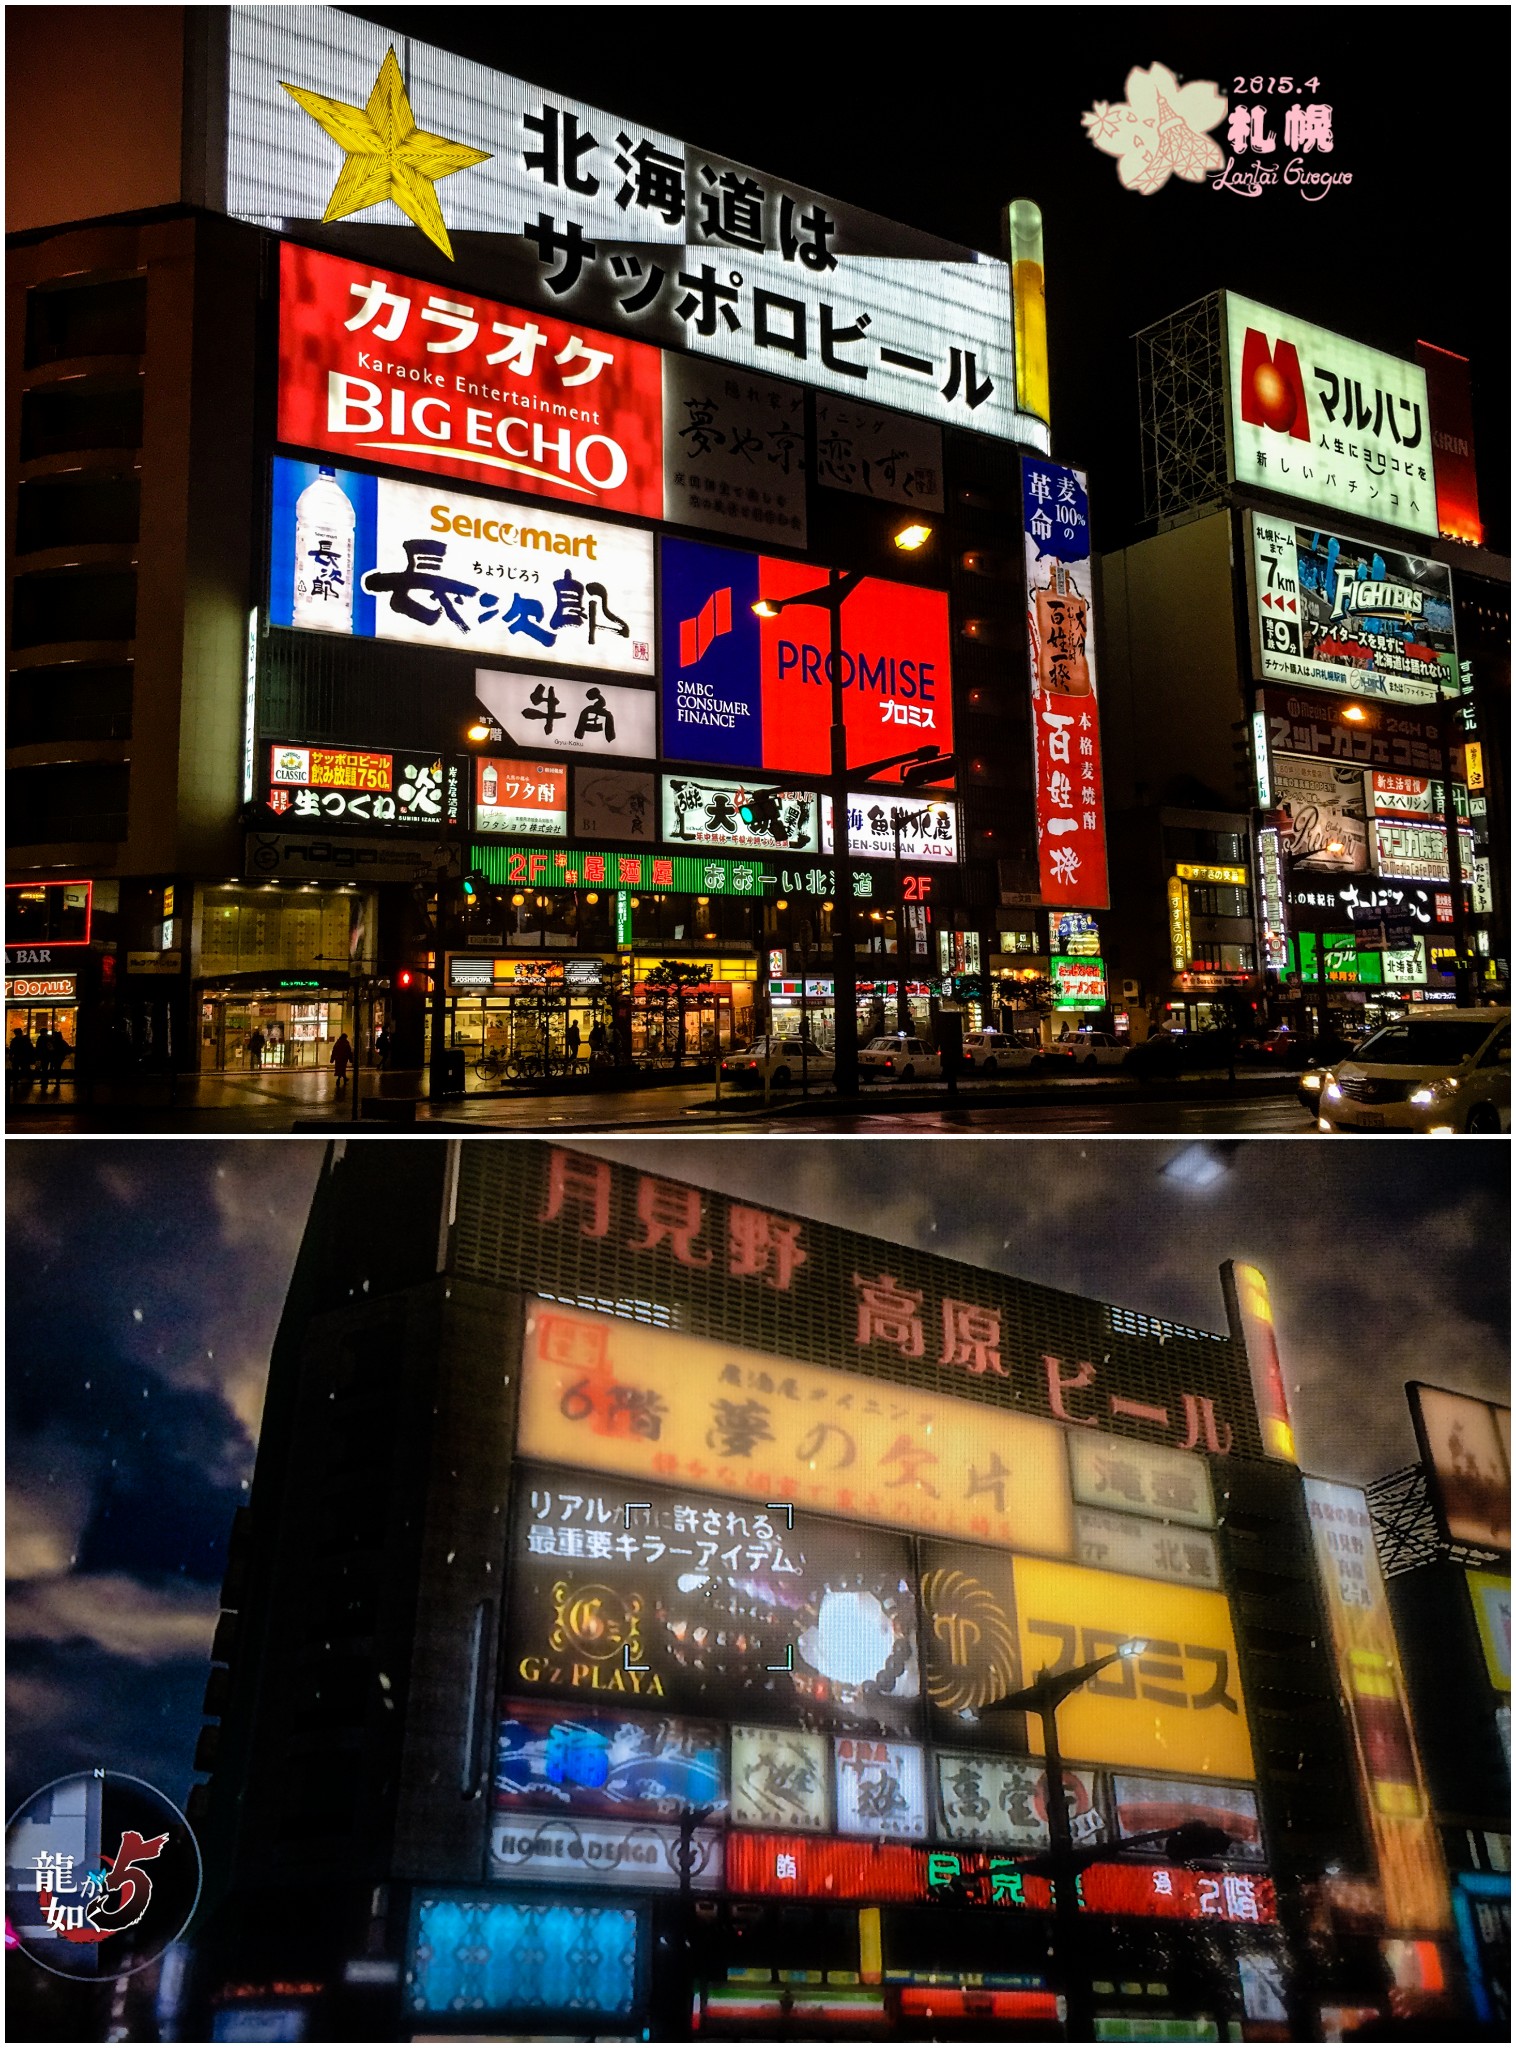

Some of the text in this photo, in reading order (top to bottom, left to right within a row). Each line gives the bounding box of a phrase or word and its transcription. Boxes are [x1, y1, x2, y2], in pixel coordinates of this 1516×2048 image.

[523, 103, 838, 272] 北海道は
[523, 213, 995, 410] サッポロビール
[344, 280, 614, 387] カラオケ
[358, 352, 600, 426] Karaoke Entertainment
[1313, 366, 1423, 448] マルハン
[328, 371, 628, 490] BIG ECHO
[1319, 433, 1427, 481] 人生にヨロコビを
[1256, 450, 1420, 512] 新しいパチンコへ
[1028, 472, 1053, 540] 革命
[1256, 526, 1295, 546] 札幌ドーム
[1269, 543, 1284, 554] まで
[308, 540, 346, 601] 長次郎
[472, 560, 541, 584] ちょうじろう
[1260, 554, 1296, 593] 7km
[364, 538, 630, 648] 長次郎
[1330, 568, 1424, 622] FIGHTERS
[1265, 618, 1275, 651] 地下鉄
[1273, 621, 1297, 654] 9分
[1309, 620, 1405, 655] ファイターズを見ずに
[778, 639, 936, 702] PROMISE
[677, 680, 714, 697] SMBC
[677, 695, 751, 716] CONSUMER
[521, 683, 616, 743] 牛角
[677, 708, 736, 728] FINANCE
[879, 699, 936, 729] プロミス
[275, 769, 307, 781] CLASSIC
[311, 752, 391, 769] サッポロビール
[1078, 712, 1097, 830] 本格麦焼酎
[505, 782, 556, 803] ワタ酎
[1041, 711, 1082, 885] 百姓一揆
[1377, 774, 1422, 793] 新生活習慣
[294, 789, 396, 820] 生つくね
[1376, 794, 1431, 811] ヘスペリジン
[827, 828, 915, 853] USEN-SUISAN
[922, 844, 941, 855] 入口
[508, 853, 548, 881] 2F
[584, 856, 673, 885] 居酒屋
[903, 876, 932, 900] 2F
[1192, 868, 1239, 882] すすきの交番
[1389, 861, 1411, 875] Media
[1411, 862, 1427, 877] Cafe
[1170, 896, 1185, 969] すすきの交番
[16, 949, 52, 963] BAR
[14, 980, 74, 996] Donut
[537, 1147, 808, 1290] 月見野
[853, 1272, 1010, 1376] 高原
[1042, 1355, 1232, 1456] ビール
[560, 1379, 669, 1443] 6階
[705, 1398, 1013, 1512] 夢の欠片
[571, 1663, 665, 1697] PLAYA
[93, 1768, 105, 1779] N
[500, 1835, 564, 1858] HOME
